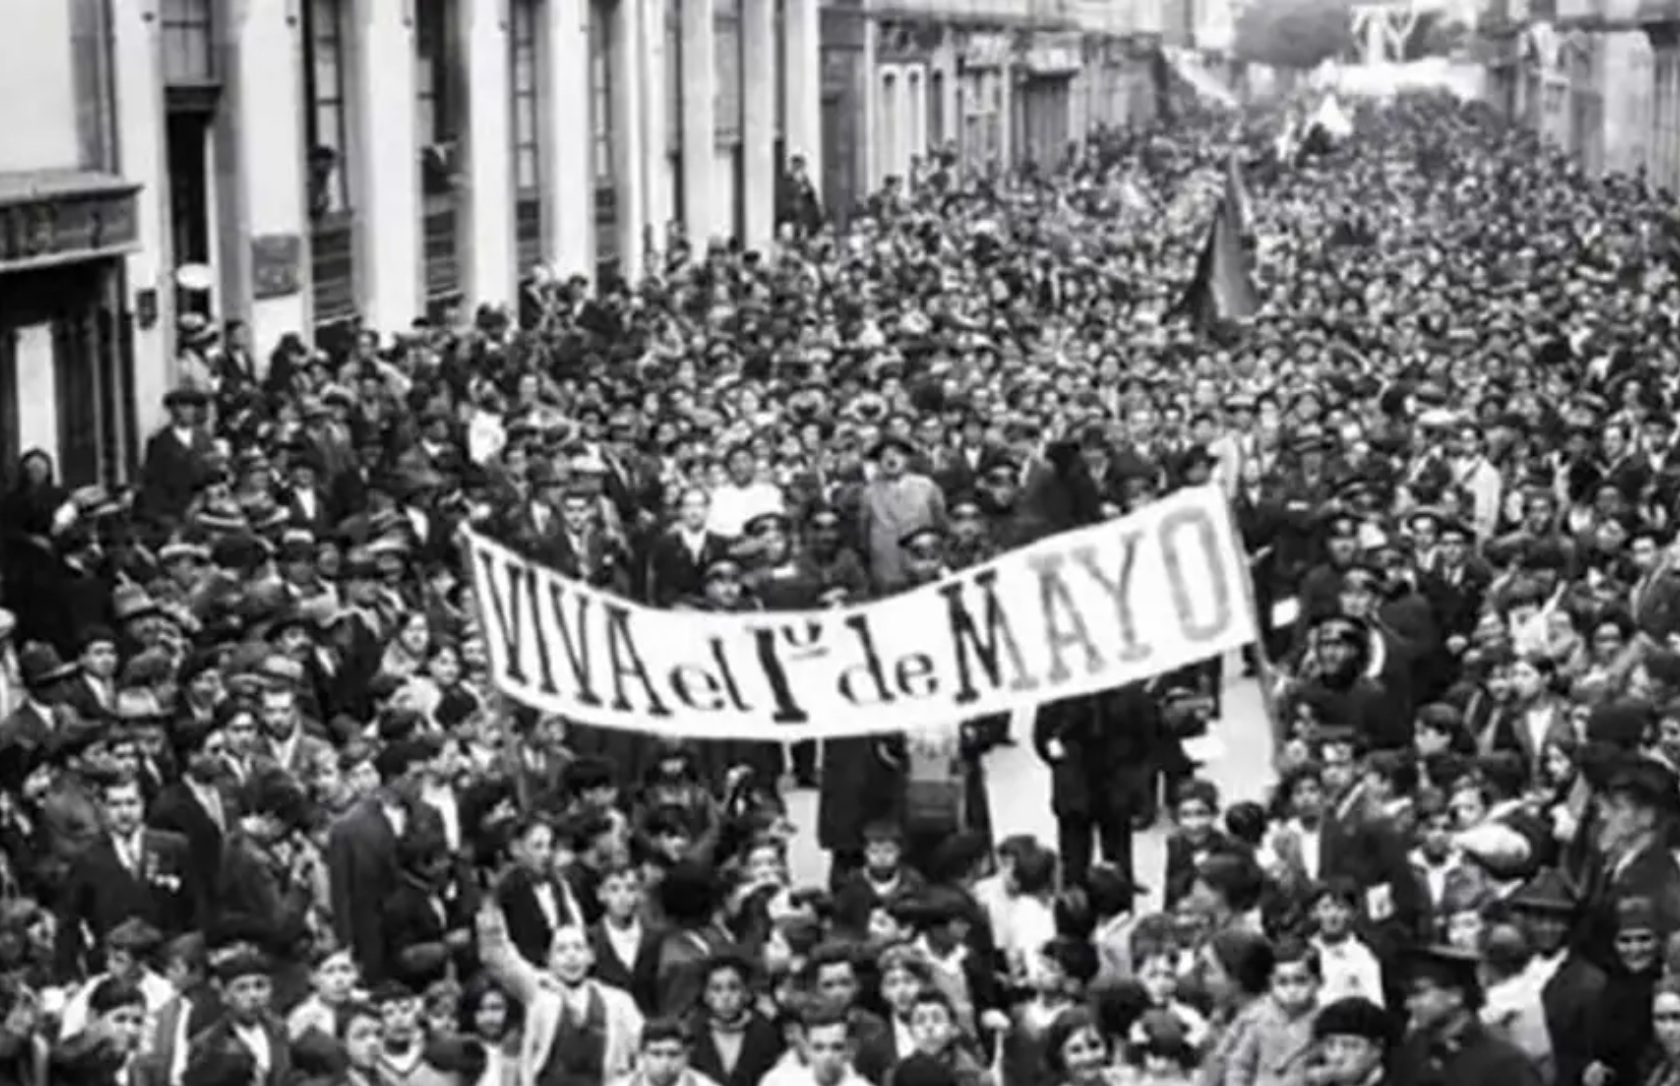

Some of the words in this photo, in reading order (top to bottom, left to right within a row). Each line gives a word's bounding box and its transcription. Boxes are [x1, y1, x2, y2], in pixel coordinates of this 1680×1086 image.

[478, 550, 672, 716] VIVA
[669, 637, 753, 712] el
[837, 614, 939, 705] de
[938, 507, 1231, 704] MAYO
